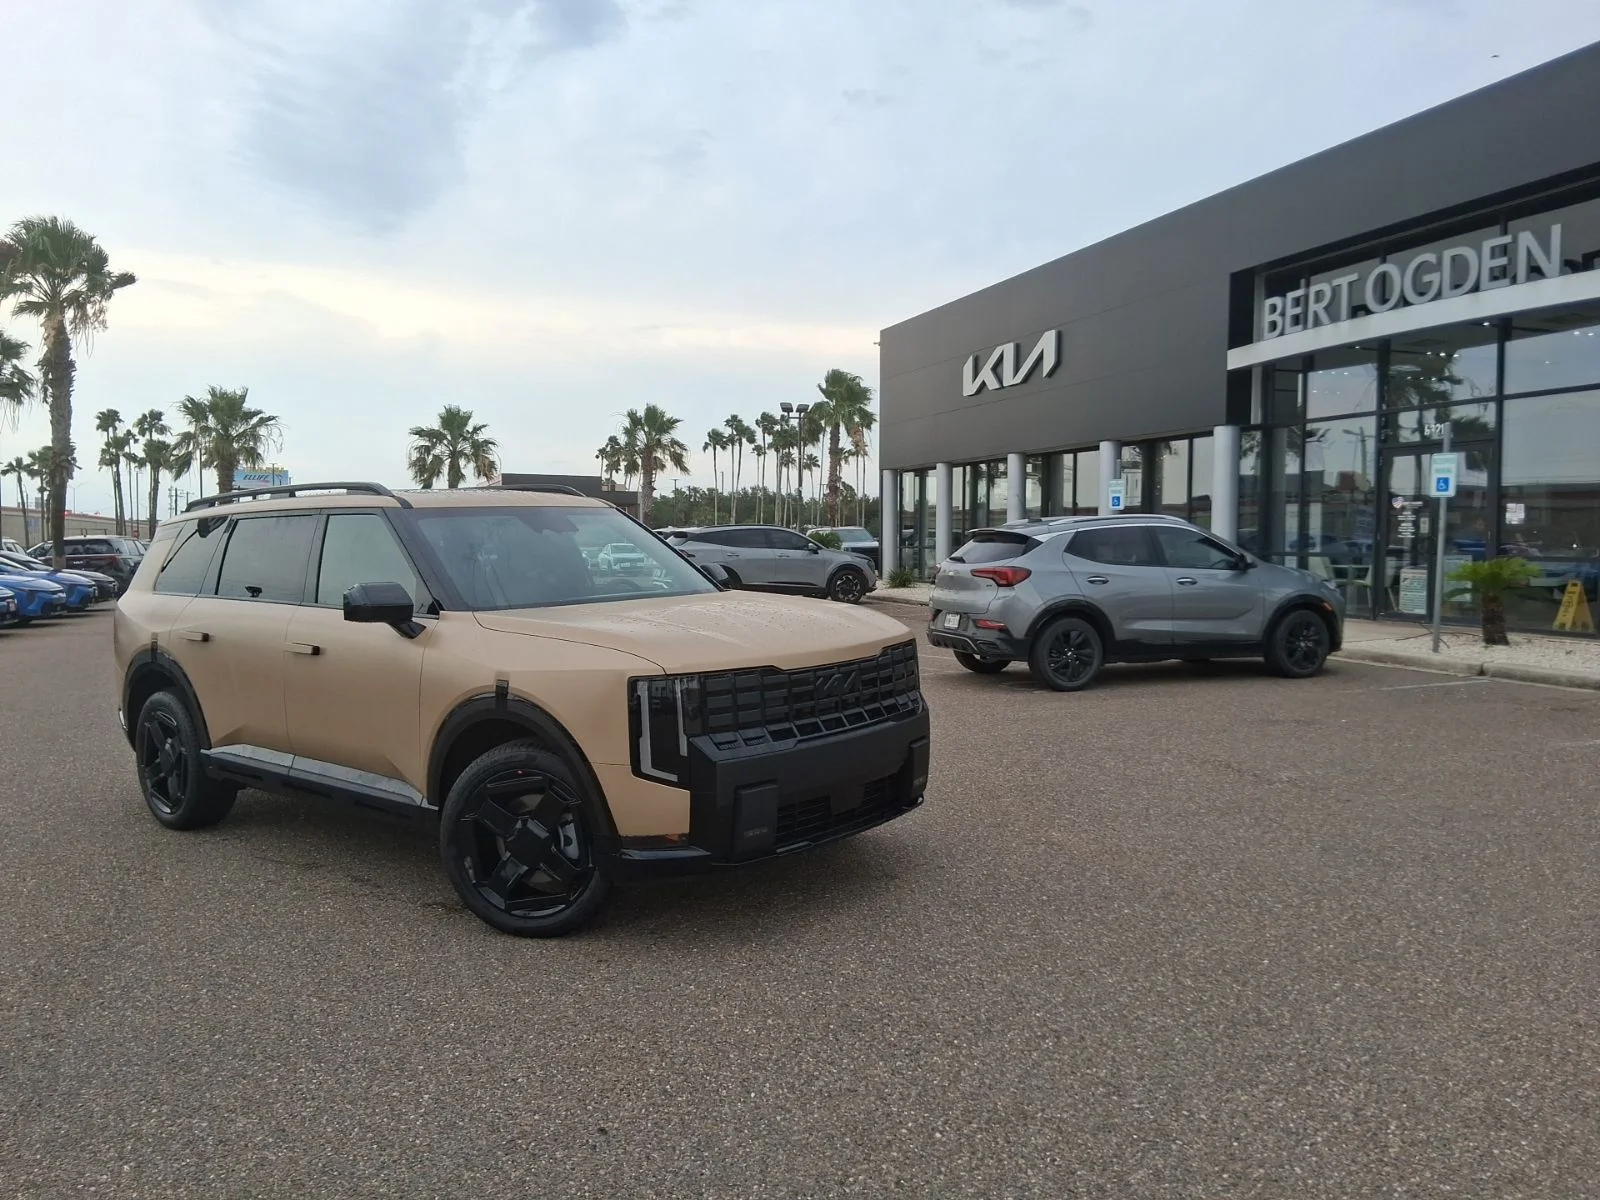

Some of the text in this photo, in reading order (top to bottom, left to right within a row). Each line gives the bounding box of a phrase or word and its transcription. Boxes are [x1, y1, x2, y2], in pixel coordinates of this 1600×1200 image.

[1263, 224, 1562, 340] BERT OGDEN
[962, 329, 1059, 397] KIA
